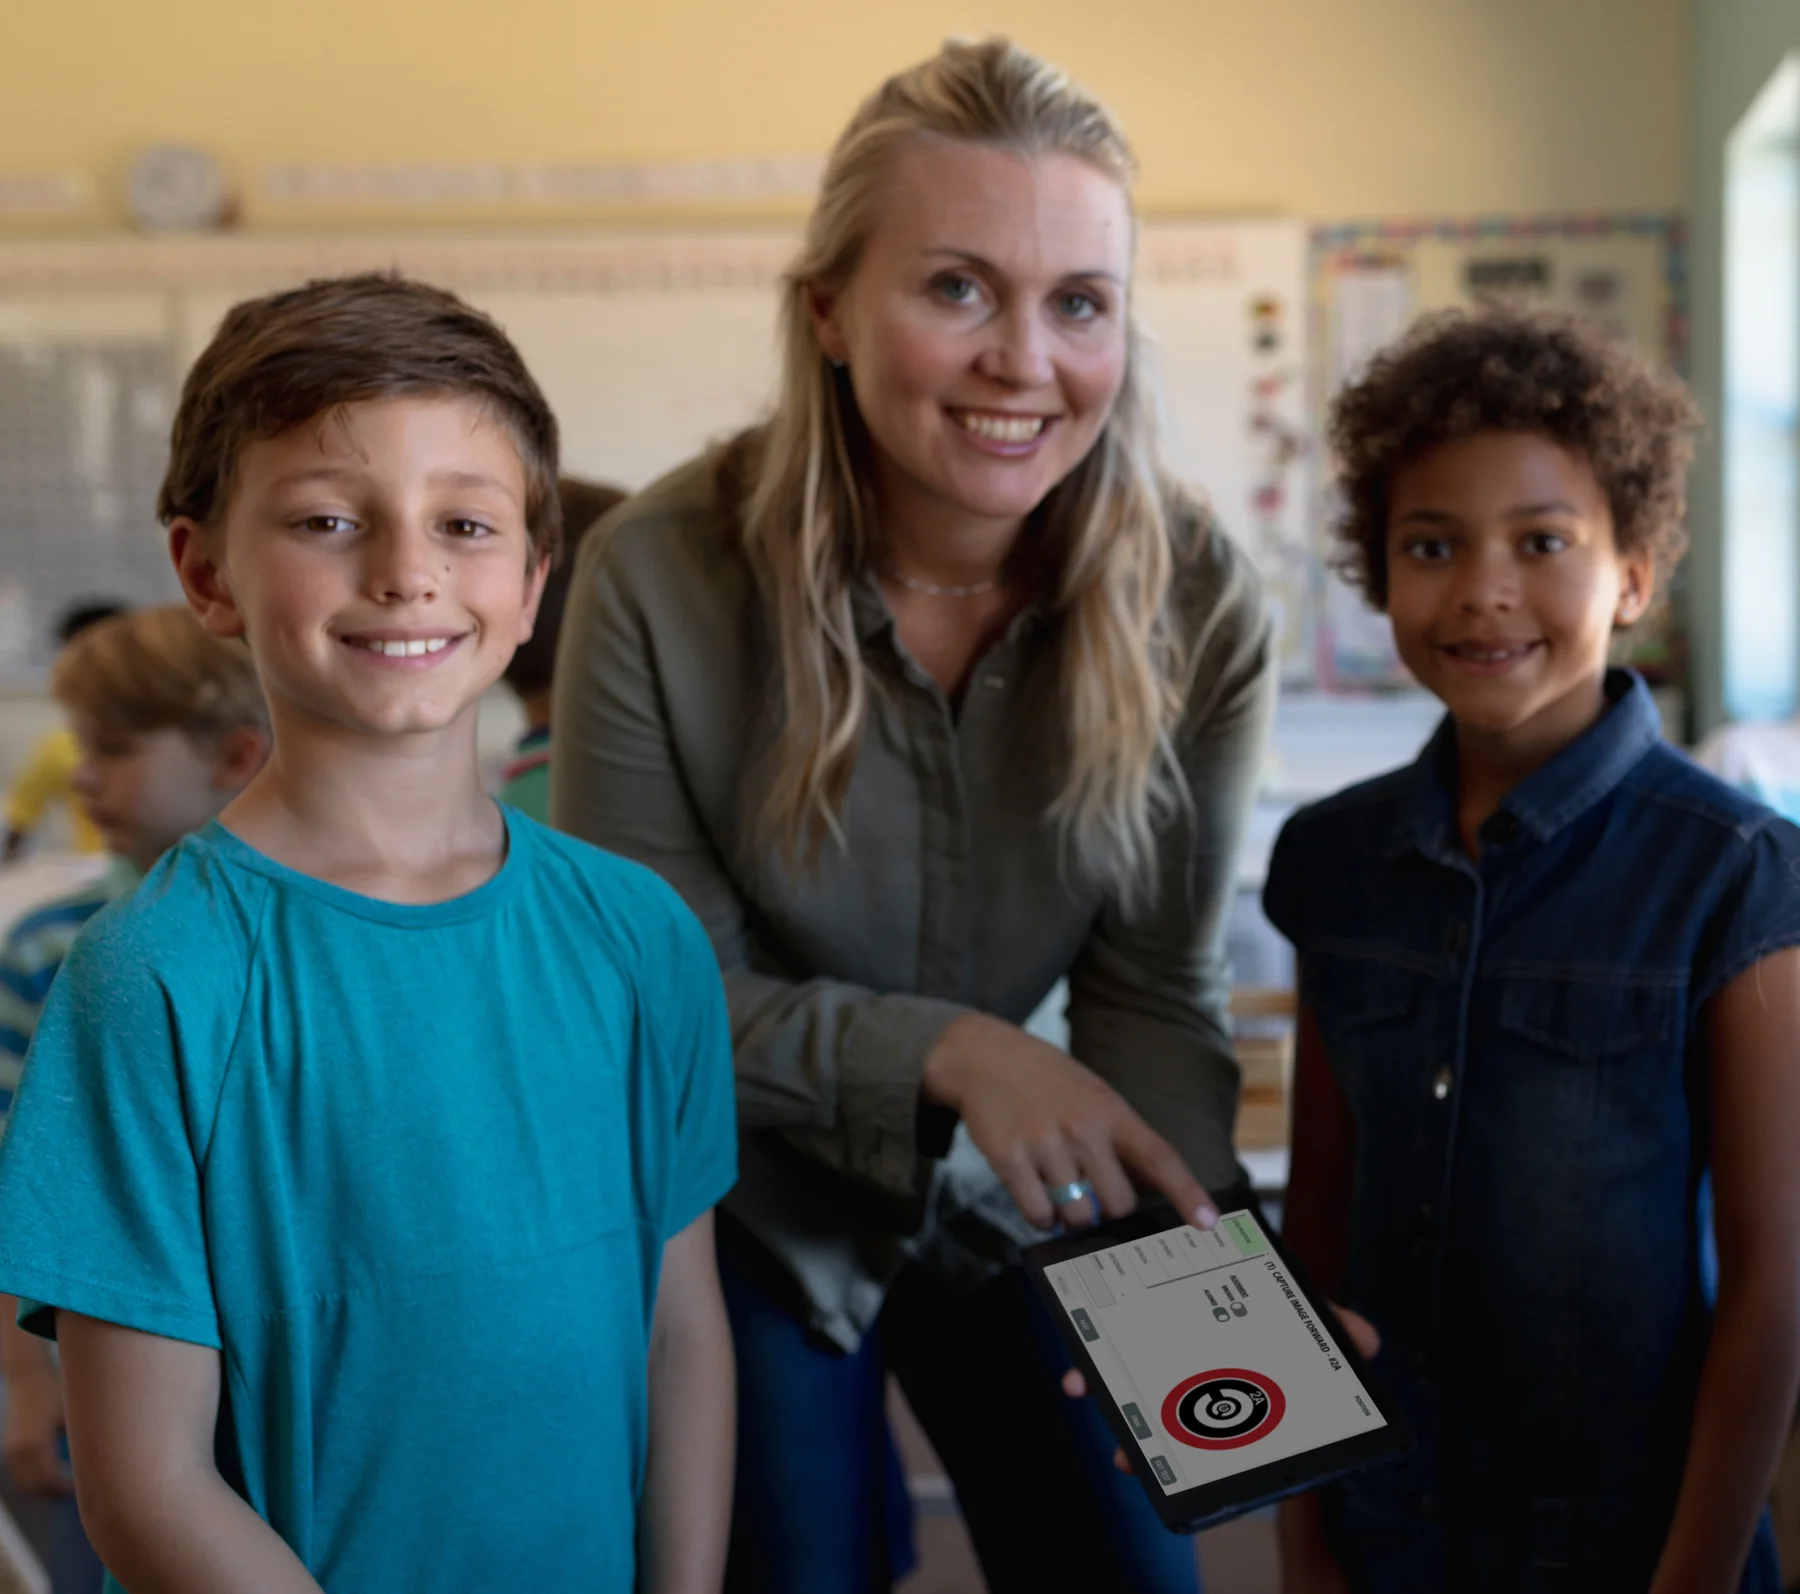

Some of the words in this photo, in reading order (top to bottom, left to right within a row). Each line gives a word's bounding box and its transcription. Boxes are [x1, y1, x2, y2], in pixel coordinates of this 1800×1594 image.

[1203, 1289, 1218, 1306] ALIGNED
[1221, 1285, 1235, 1301] BROKEN
[1264, 1261, 1277, 1270] (1)
[1272, 1271, 1296, 1298] CAPTURE
[1290, 1299, 1309, 1320] IMAGE
[1304, 1320, 1330, 1353] FORWARD
[1328, 1357, 1342, 1371] #2A
[1249, 1391, 1265, 1404] 2A
[1354, 1395, 1370, 1417] POSITION
